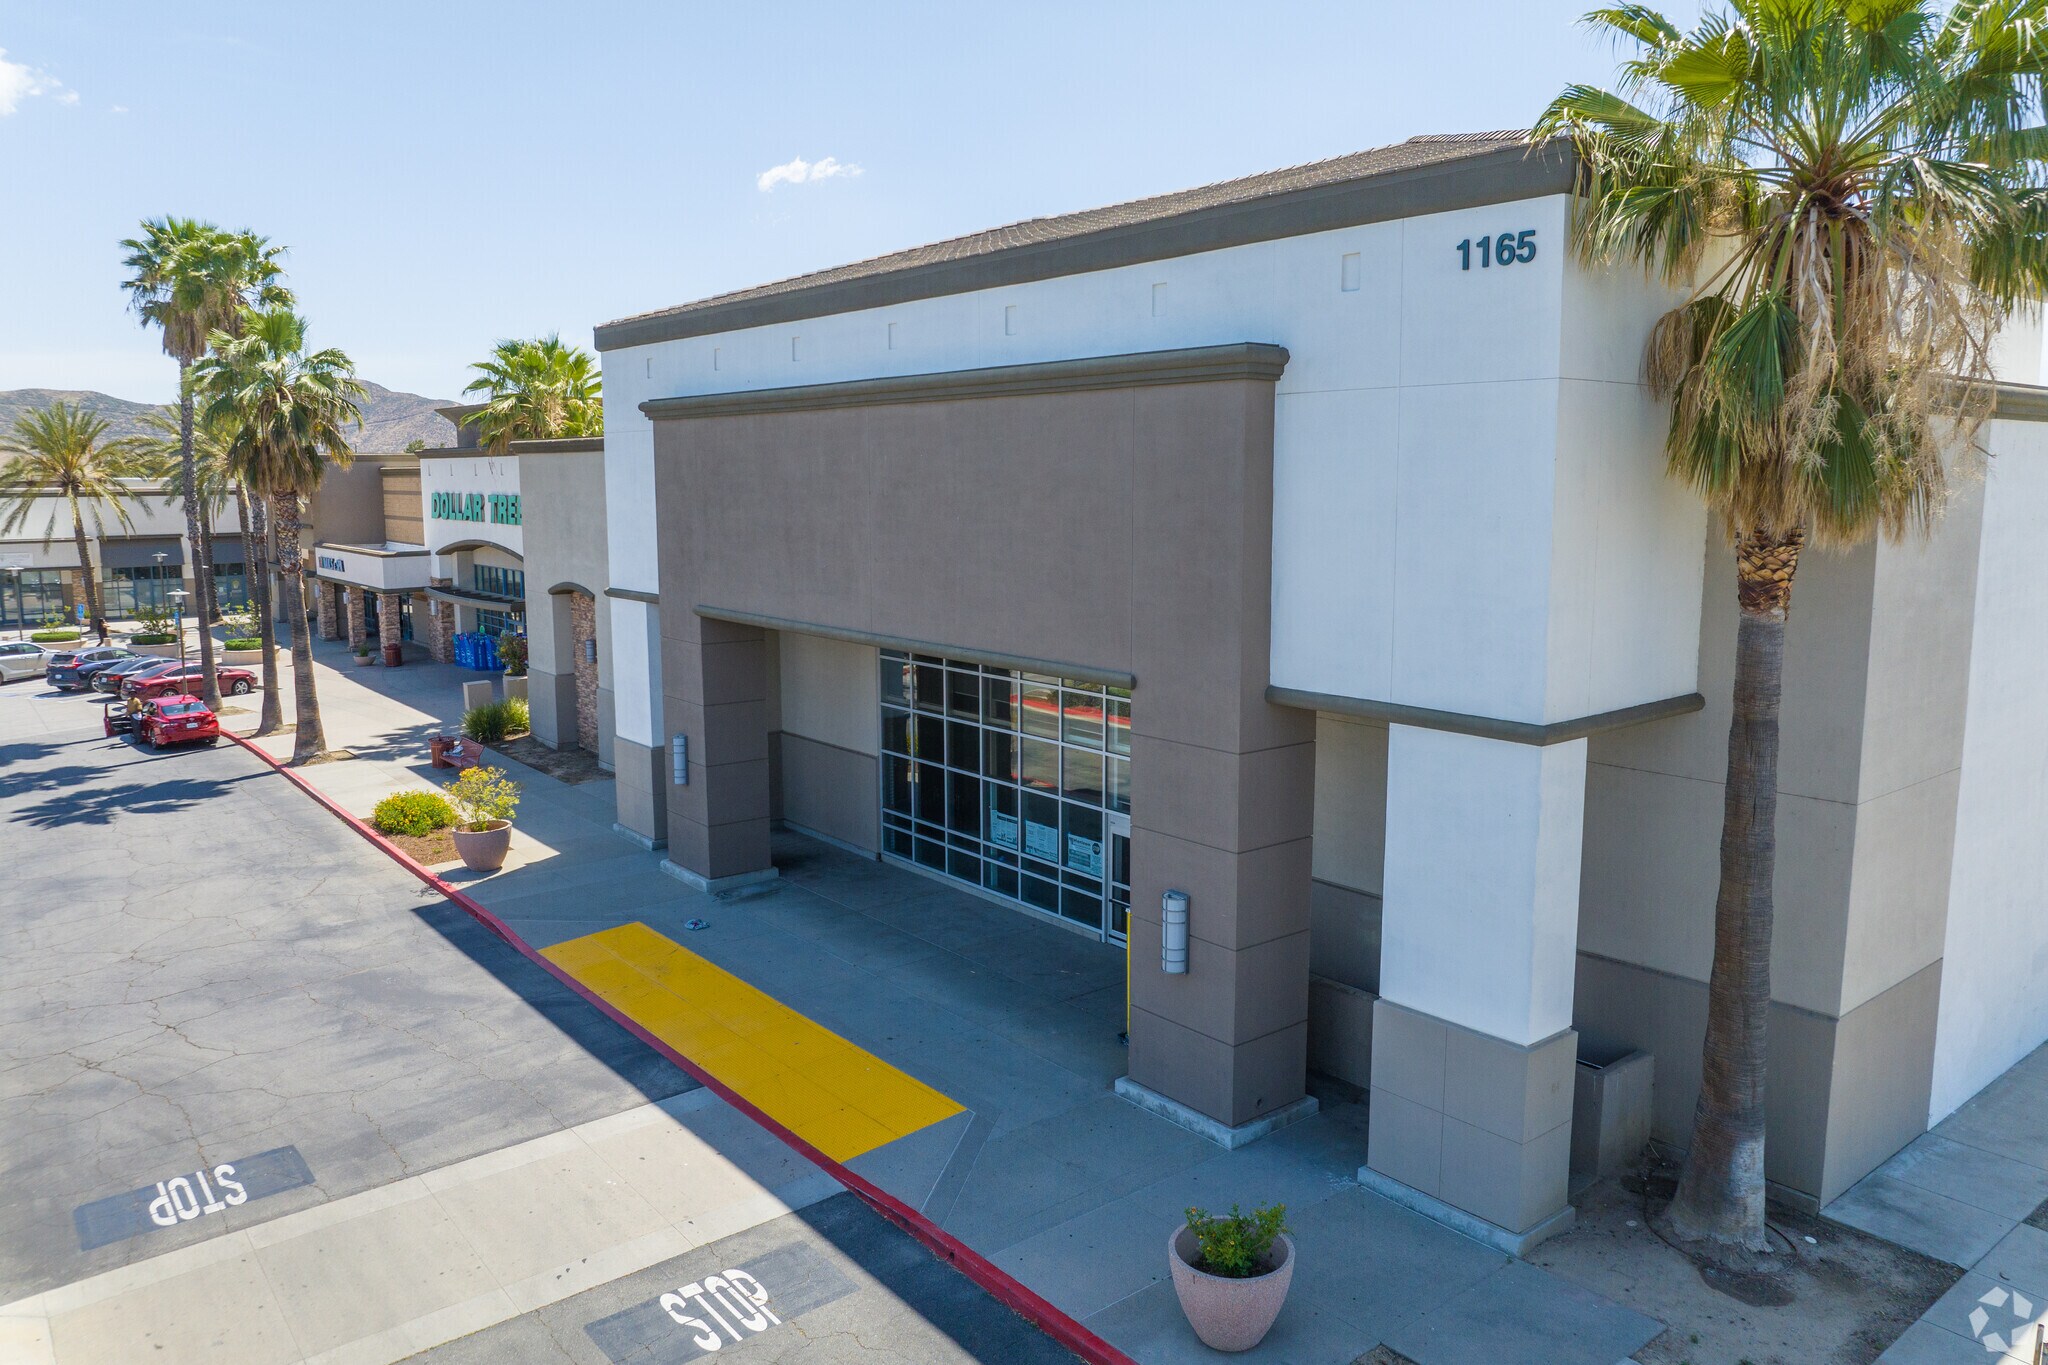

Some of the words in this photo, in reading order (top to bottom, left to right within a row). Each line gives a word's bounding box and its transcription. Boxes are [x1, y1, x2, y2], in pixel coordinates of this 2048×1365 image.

[1456, 229, 1537, 271] 1165
[431, 491, 485, 522] DOLLAR
[149, 1164, 248, 1226] STOP
[660, 1269, 782, 1351] STOP
